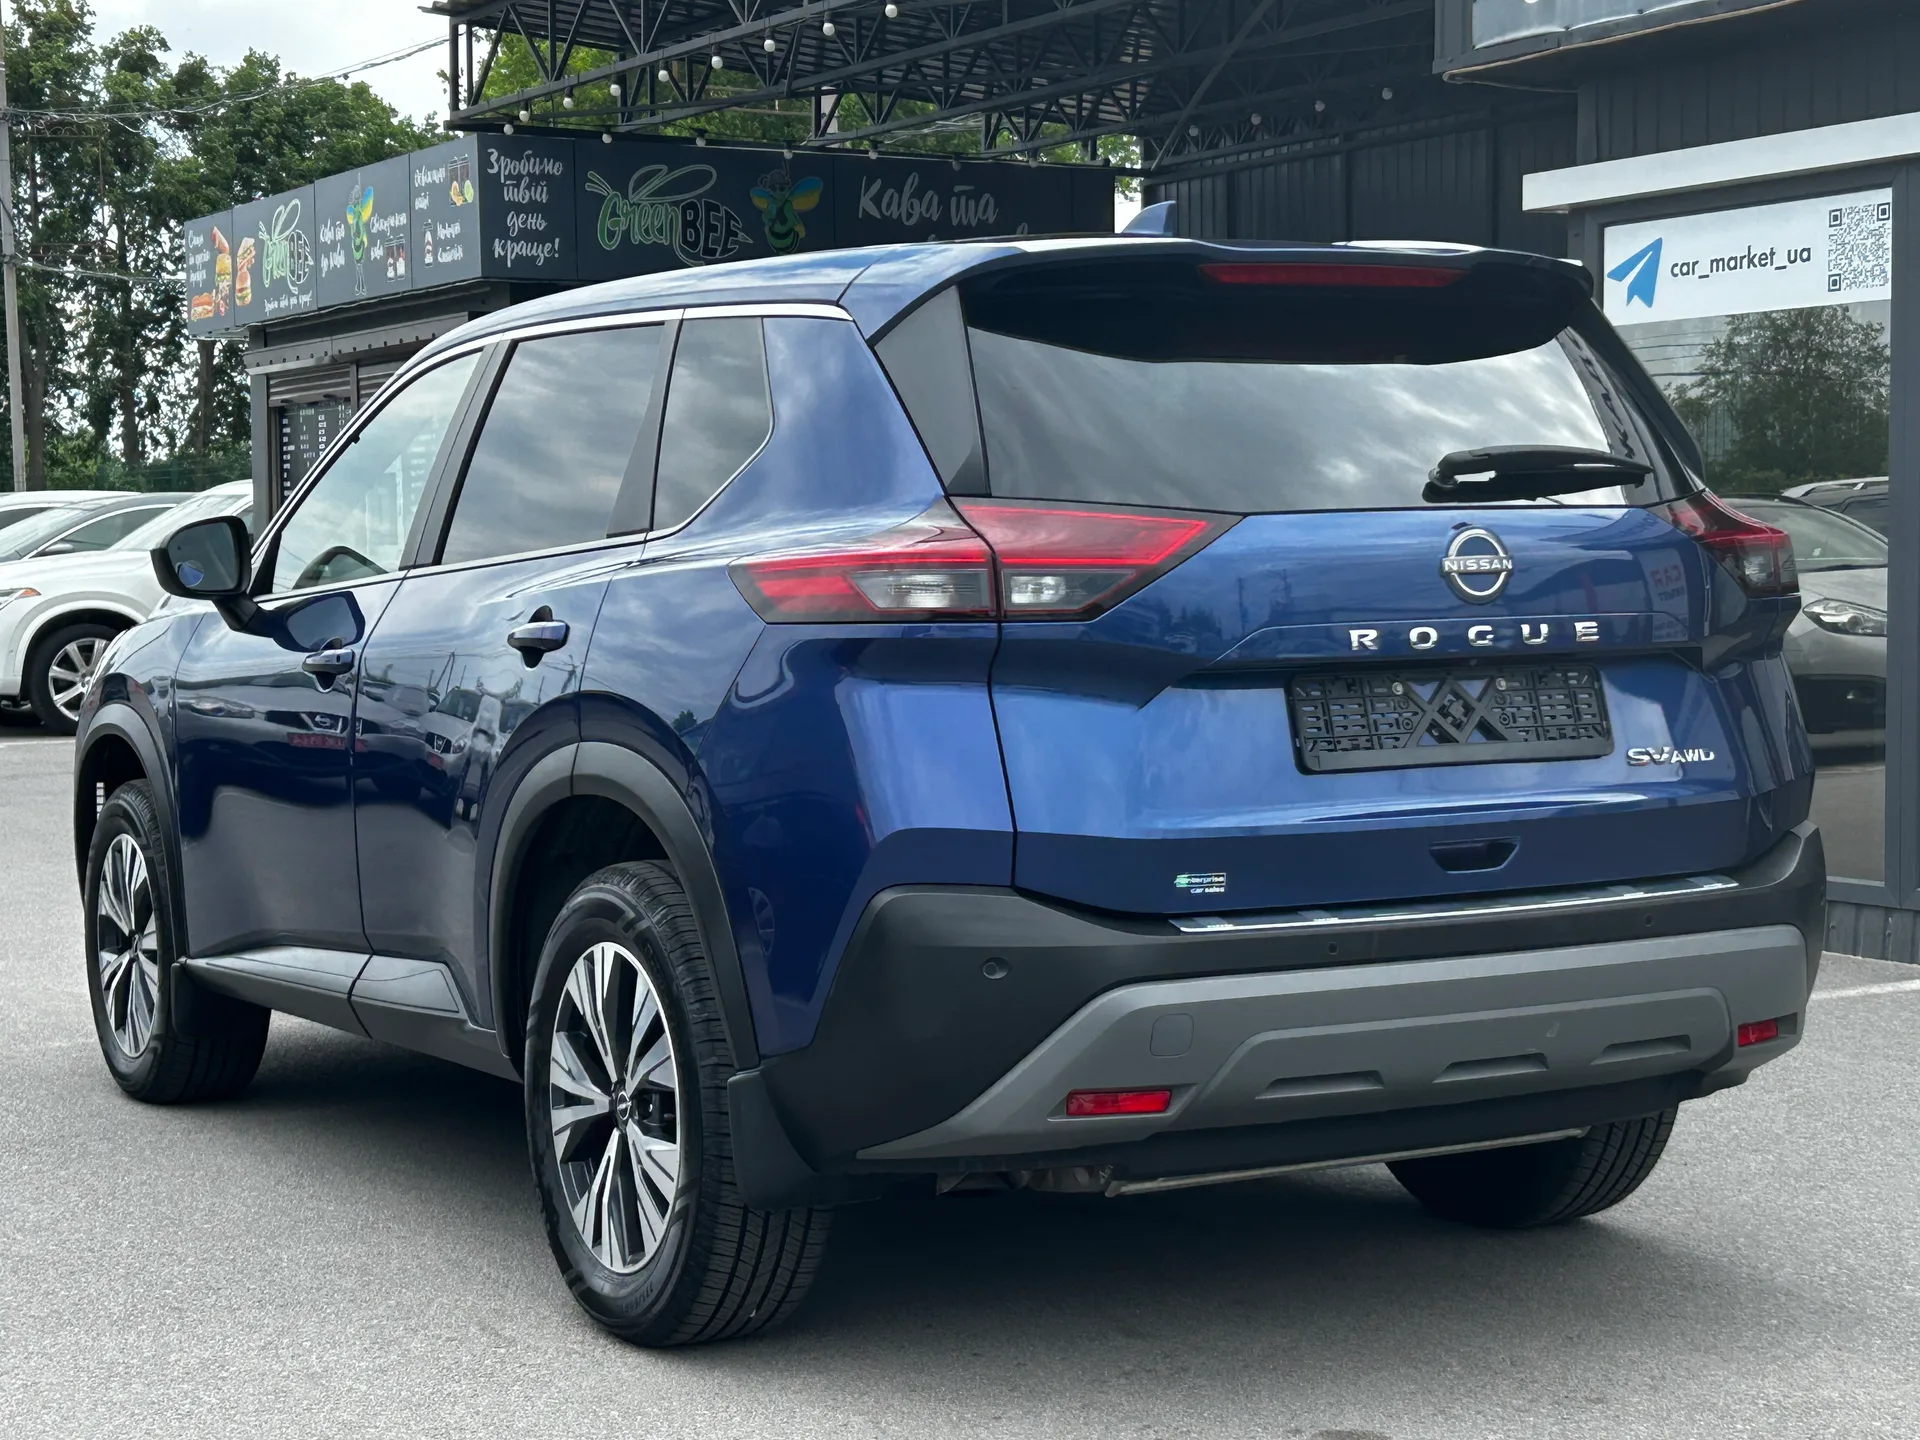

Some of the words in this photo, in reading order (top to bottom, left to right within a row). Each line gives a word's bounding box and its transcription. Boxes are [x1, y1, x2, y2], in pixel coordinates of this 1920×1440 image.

[486, 148, 563, 184] Зробимо
[503, 176, 549, 204] твій
[859, 172, 943, 226] Кава
[950, 185, 999, 227] та
[506, 211, 548, 237] день
[492, 237, 560, 268] краще!
[1670, 244, 1812, 279] car_market_ua
[1444, 558, 1513, 572] NISSAN
[1349, 620, 1600, 651] ROGUE
